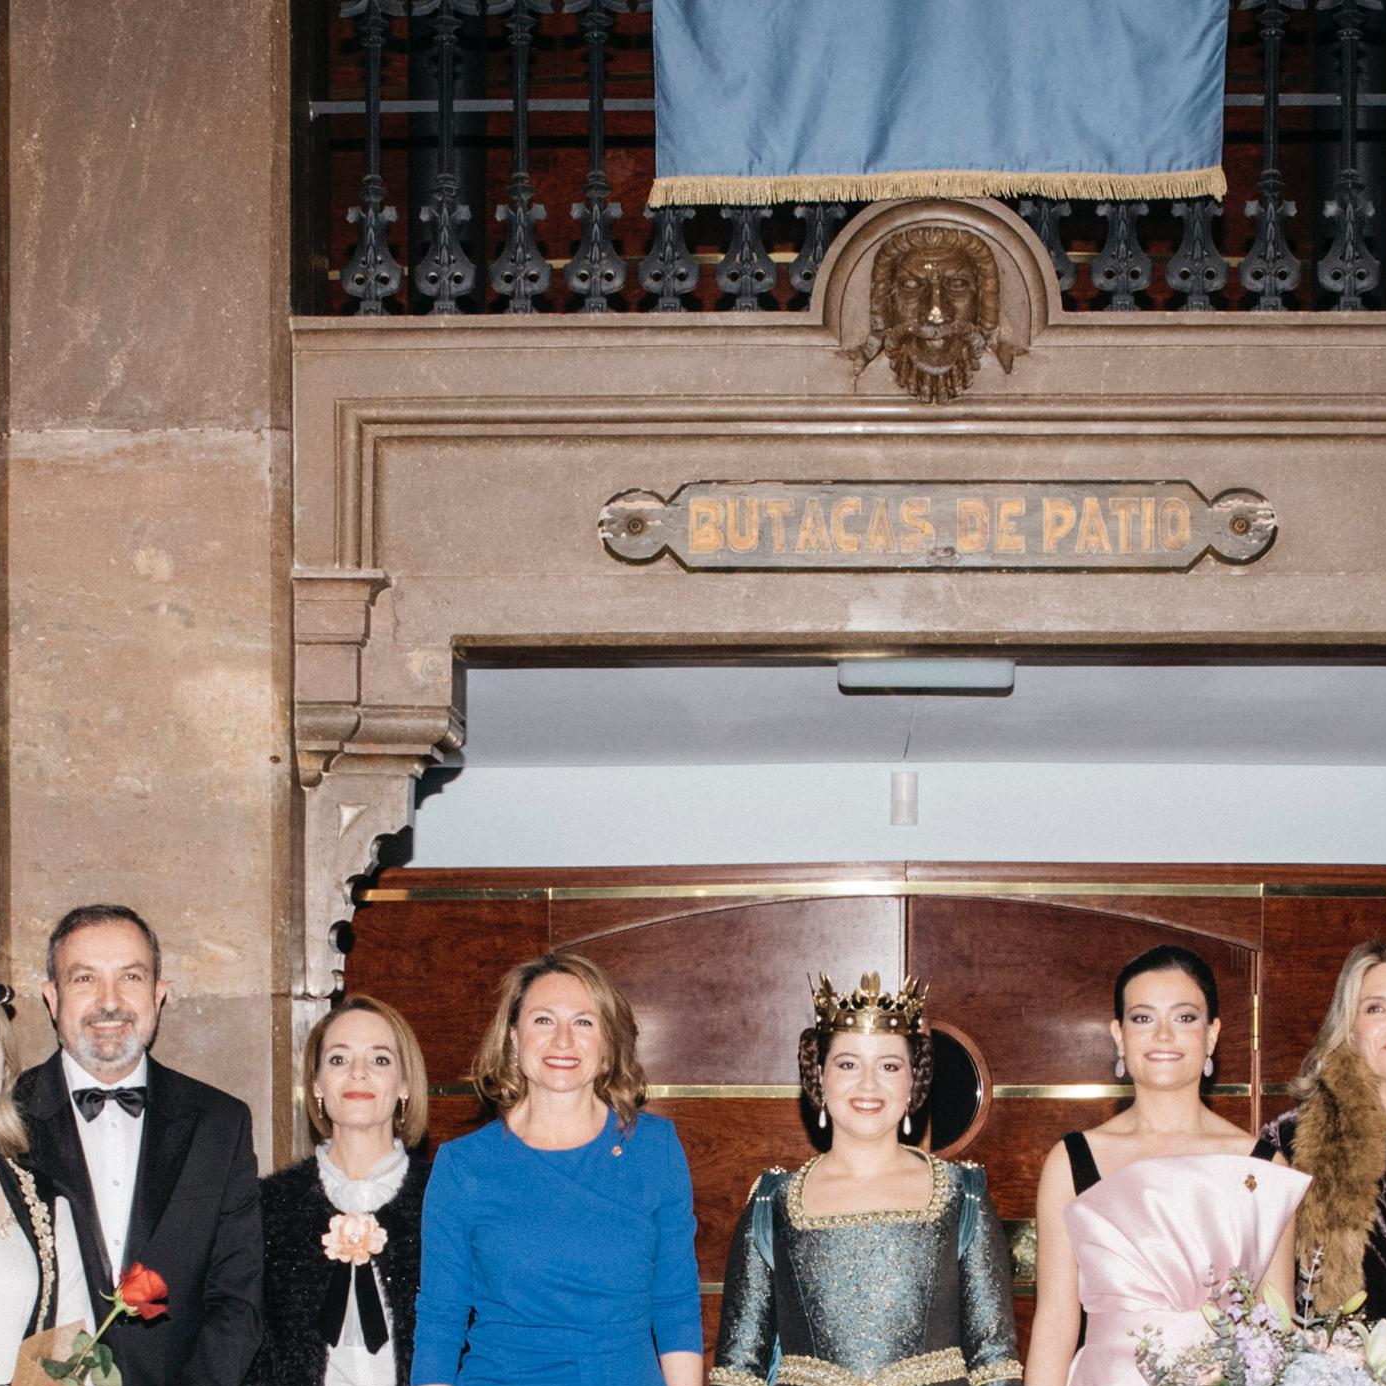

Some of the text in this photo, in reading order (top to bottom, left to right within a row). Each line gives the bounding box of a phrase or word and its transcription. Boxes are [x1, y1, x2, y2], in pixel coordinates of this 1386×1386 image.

[689, 496, 1191, 553] BUTACAS DE PATIO
